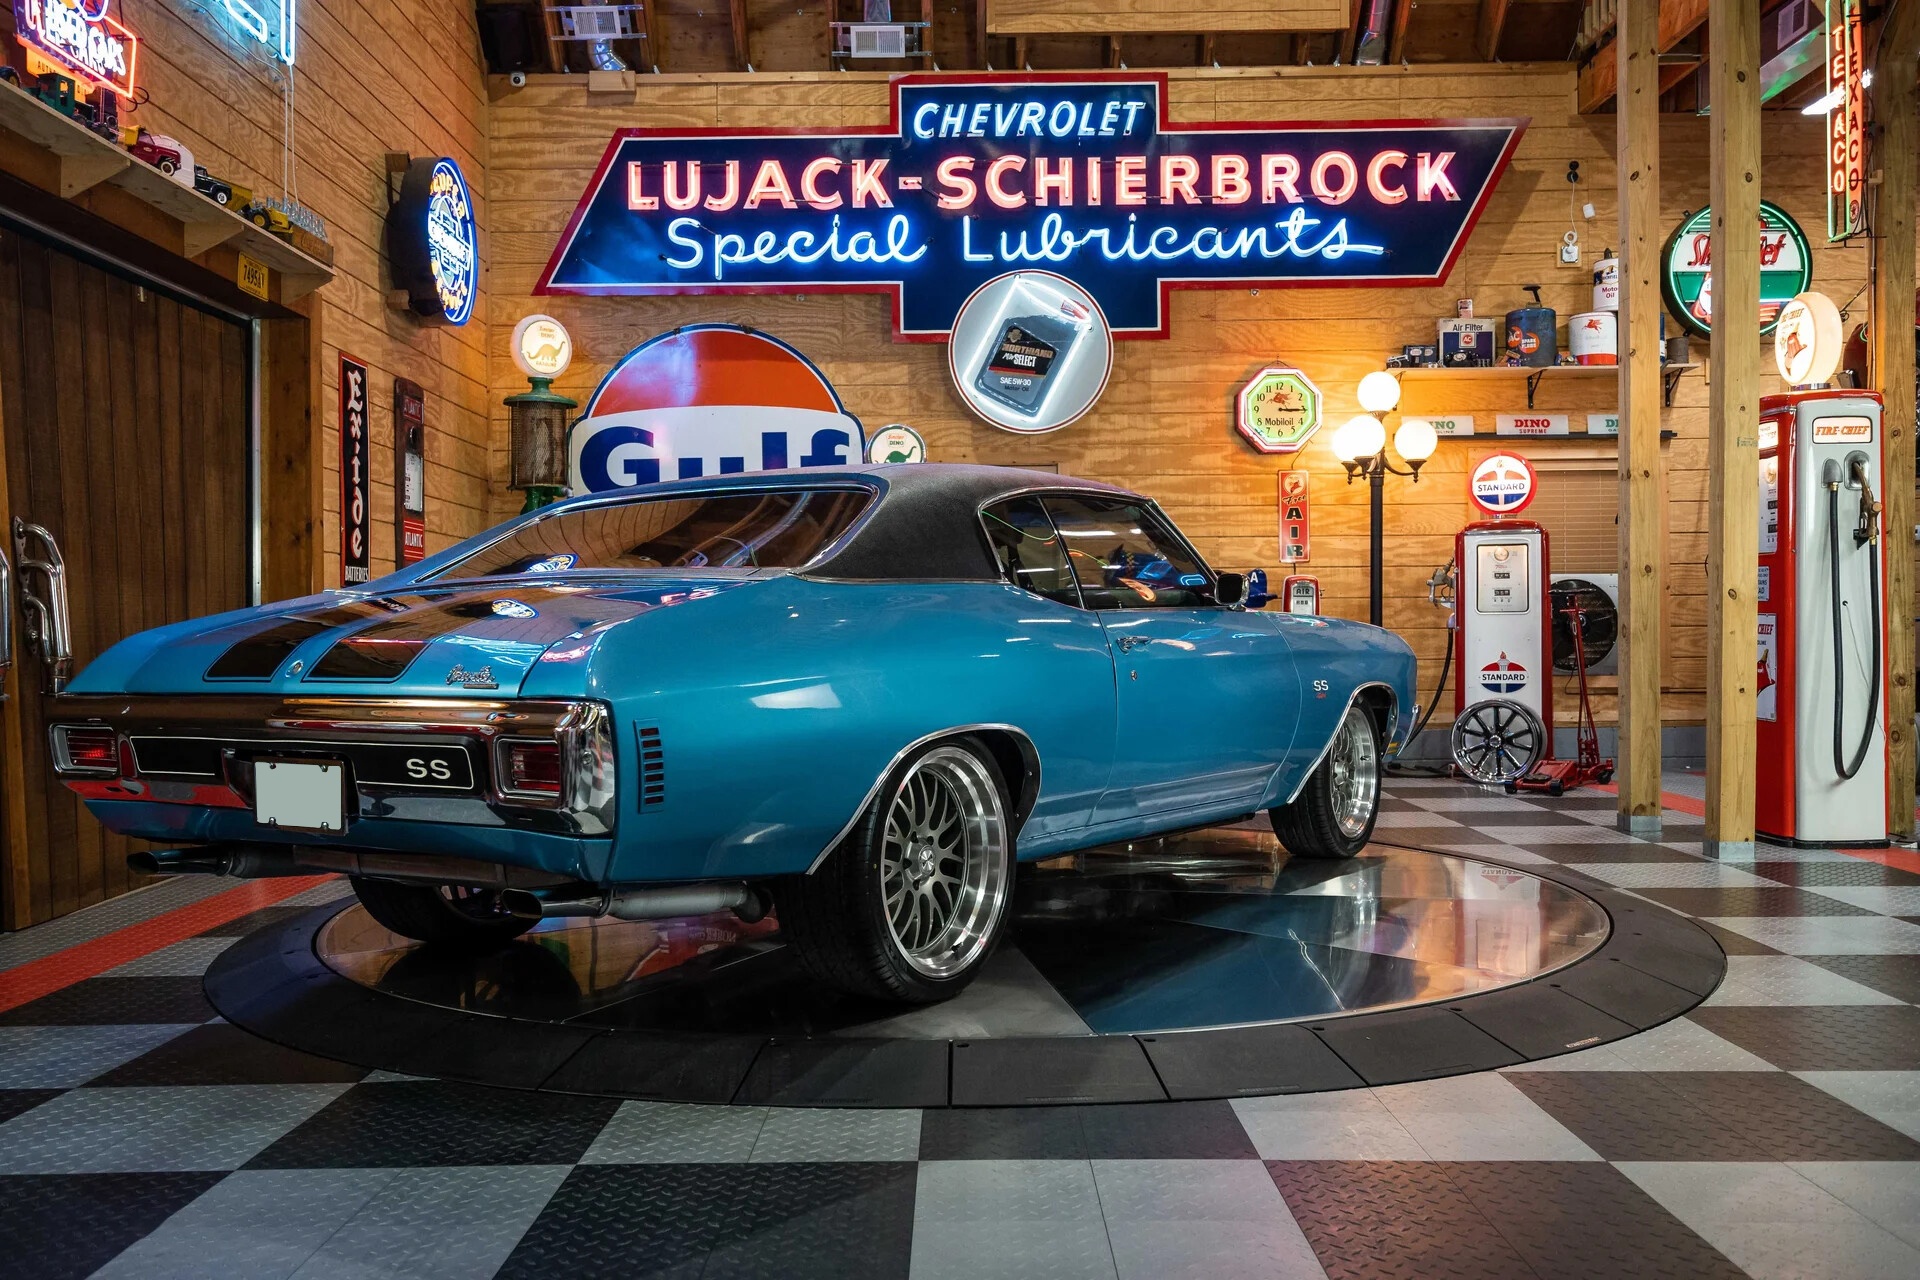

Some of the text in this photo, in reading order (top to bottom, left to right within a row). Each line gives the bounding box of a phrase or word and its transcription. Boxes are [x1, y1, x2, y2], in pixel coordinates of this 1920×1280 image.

[1848, 22, 1859, 191] TEXACO
[913, 101, 1146, 138] CHEVROLET
[628, 151, 1461, 210] LUJACK-SCHIERBROCK
[665, 207, 1384, 280] Special Lubricants
[1453, 323, 1484, 331] Air Filter
[1000, 376, 1013, 385] SAE
[1265, 385, 1272, 393] 11
[1276, 382, 1284, 391] 12
[1256, 393, 1266, 402] 10
[1298, 393, 1303, 401] 2
[1256, 418, 1263, 426] 8
[1265, 417, 1294, 426] Mobiloil
[1298, 417, 1304, 426] 4
[1514, 419, 1551, 428] DINO
[1605, 419, 1618, 428] DI
[1278, 429, 1284, 437] 6
[1291, 426, 1296, 434] 5
[1815, 425, 1870, 435] FIRE-CHIEF
[347, 369, 363, 559] Exide
[1477, 482, 1525, 492] STANDARD
[1285, 506, 1304, 557] AIR
[404, 534, 423, 548] ATLANTIC
[345, 565, 369, 582] BATTERIES
[1296, 587, 1311, 595] AIR
[1482, 673, 1526, 681] STANDARD
[1313, 679, 1329, 691] SS
[406, 758, 451, 780] SS
